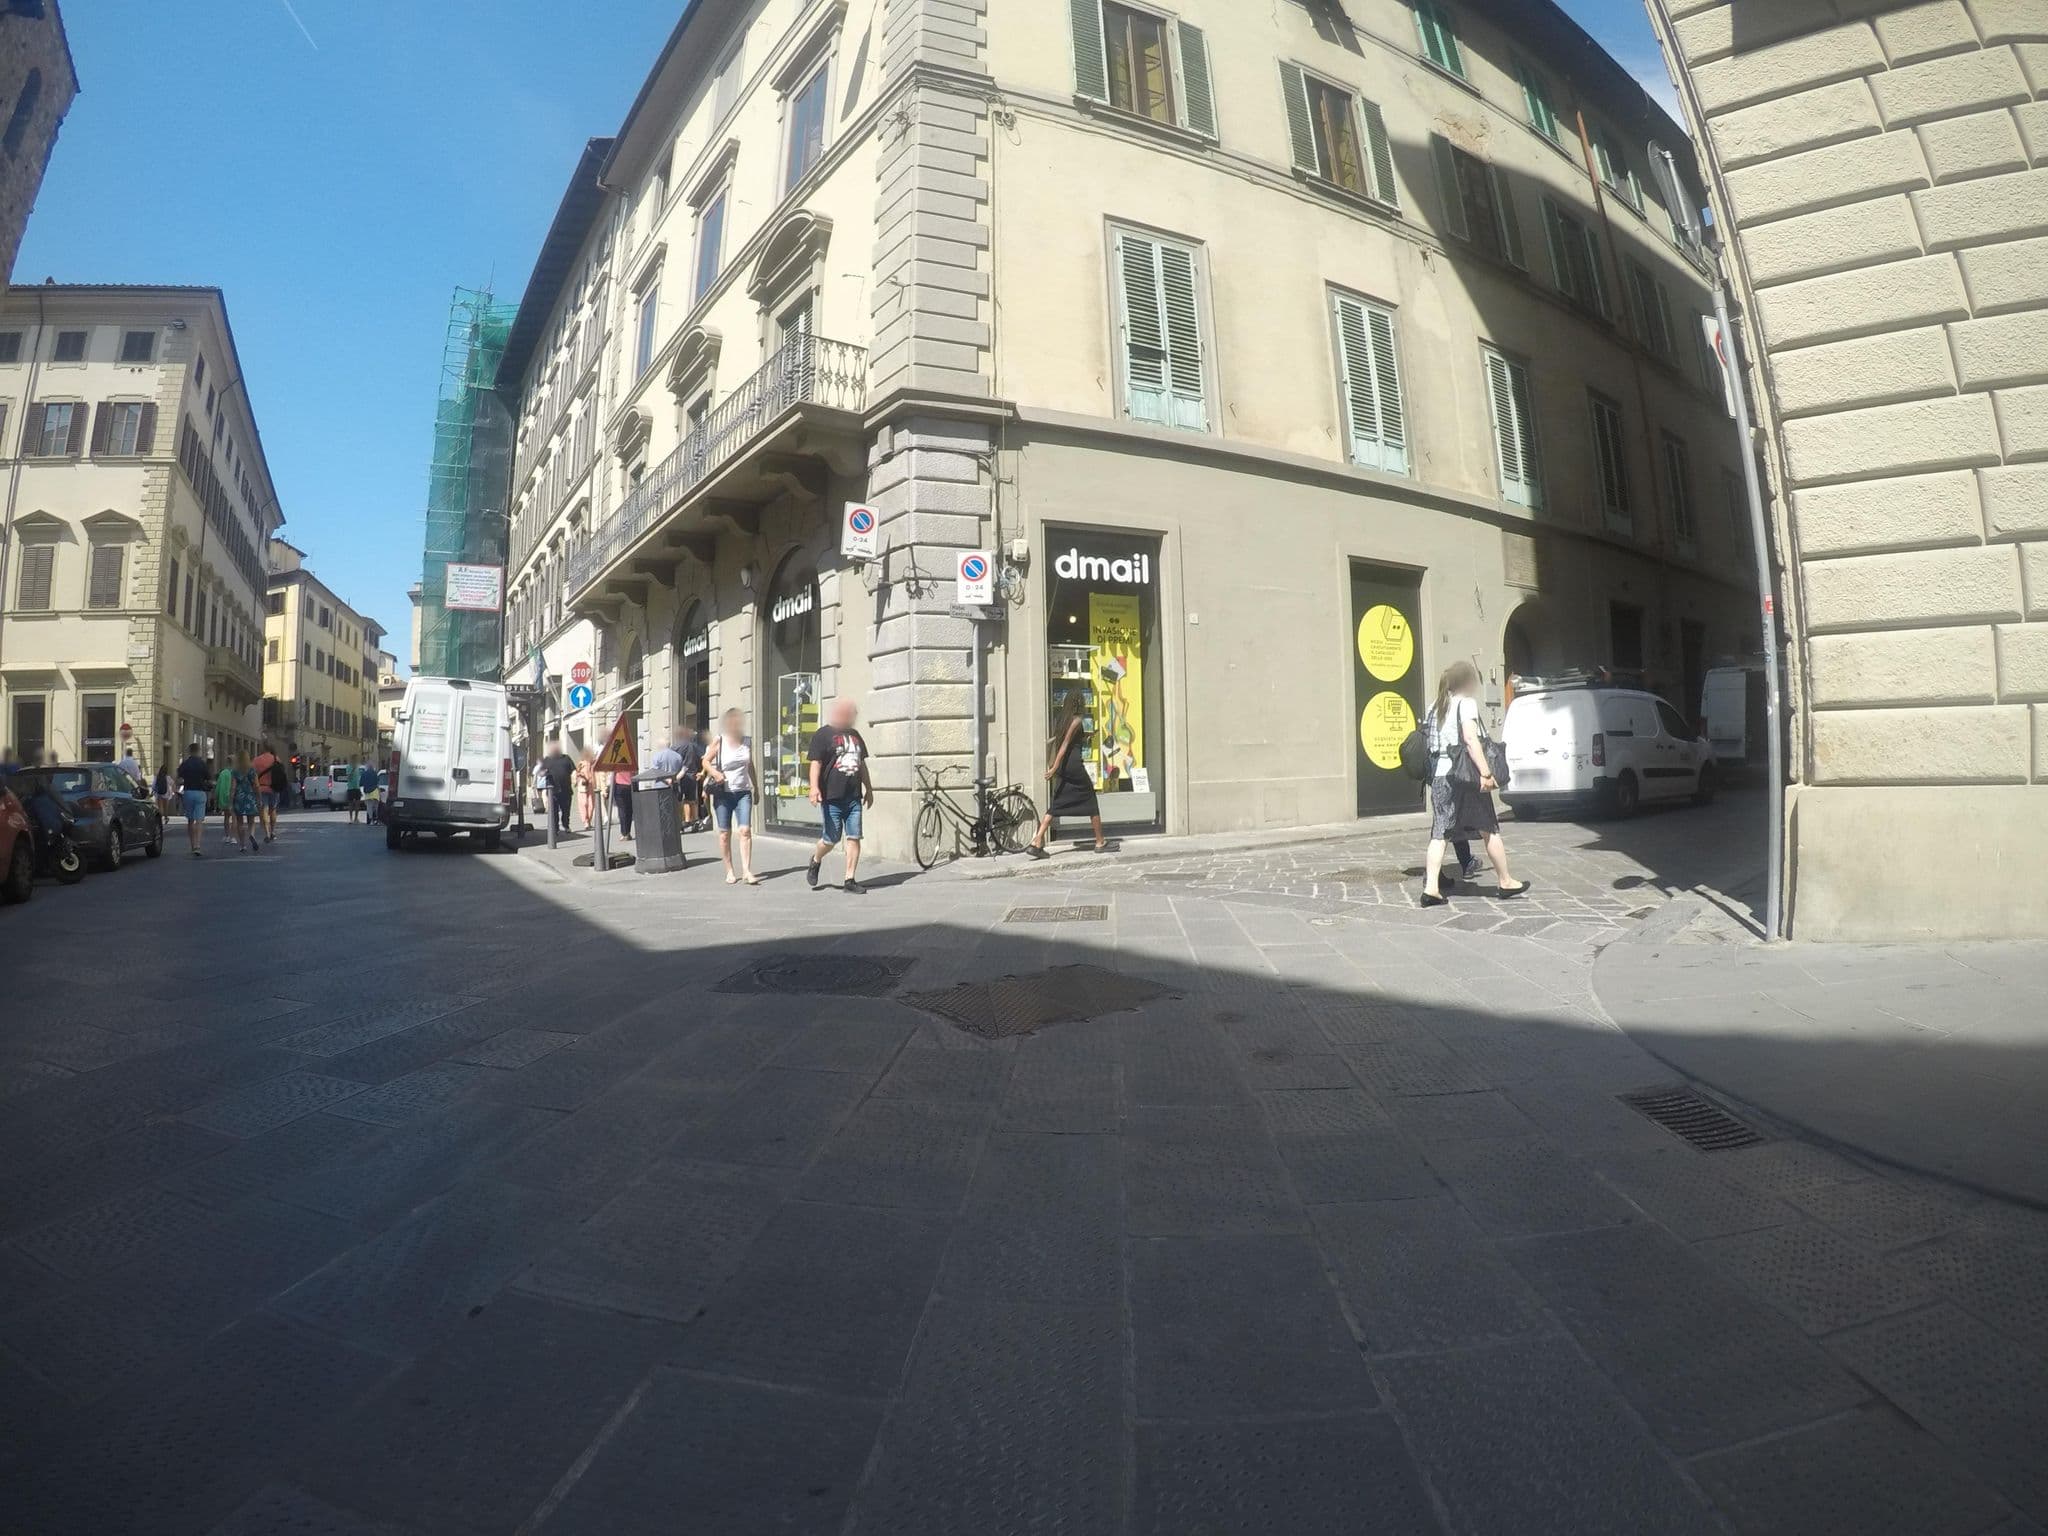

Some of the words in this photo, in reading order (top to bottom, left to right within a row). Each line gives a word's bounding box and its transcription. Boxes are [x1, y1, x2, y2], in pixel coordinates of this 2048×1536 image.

[1055, 547, 1150, 584] dmail
[772, 584, 813, 623] dmail
[683, 627, 707, 657] dmail
[572, 668, 592, 678] STOP
